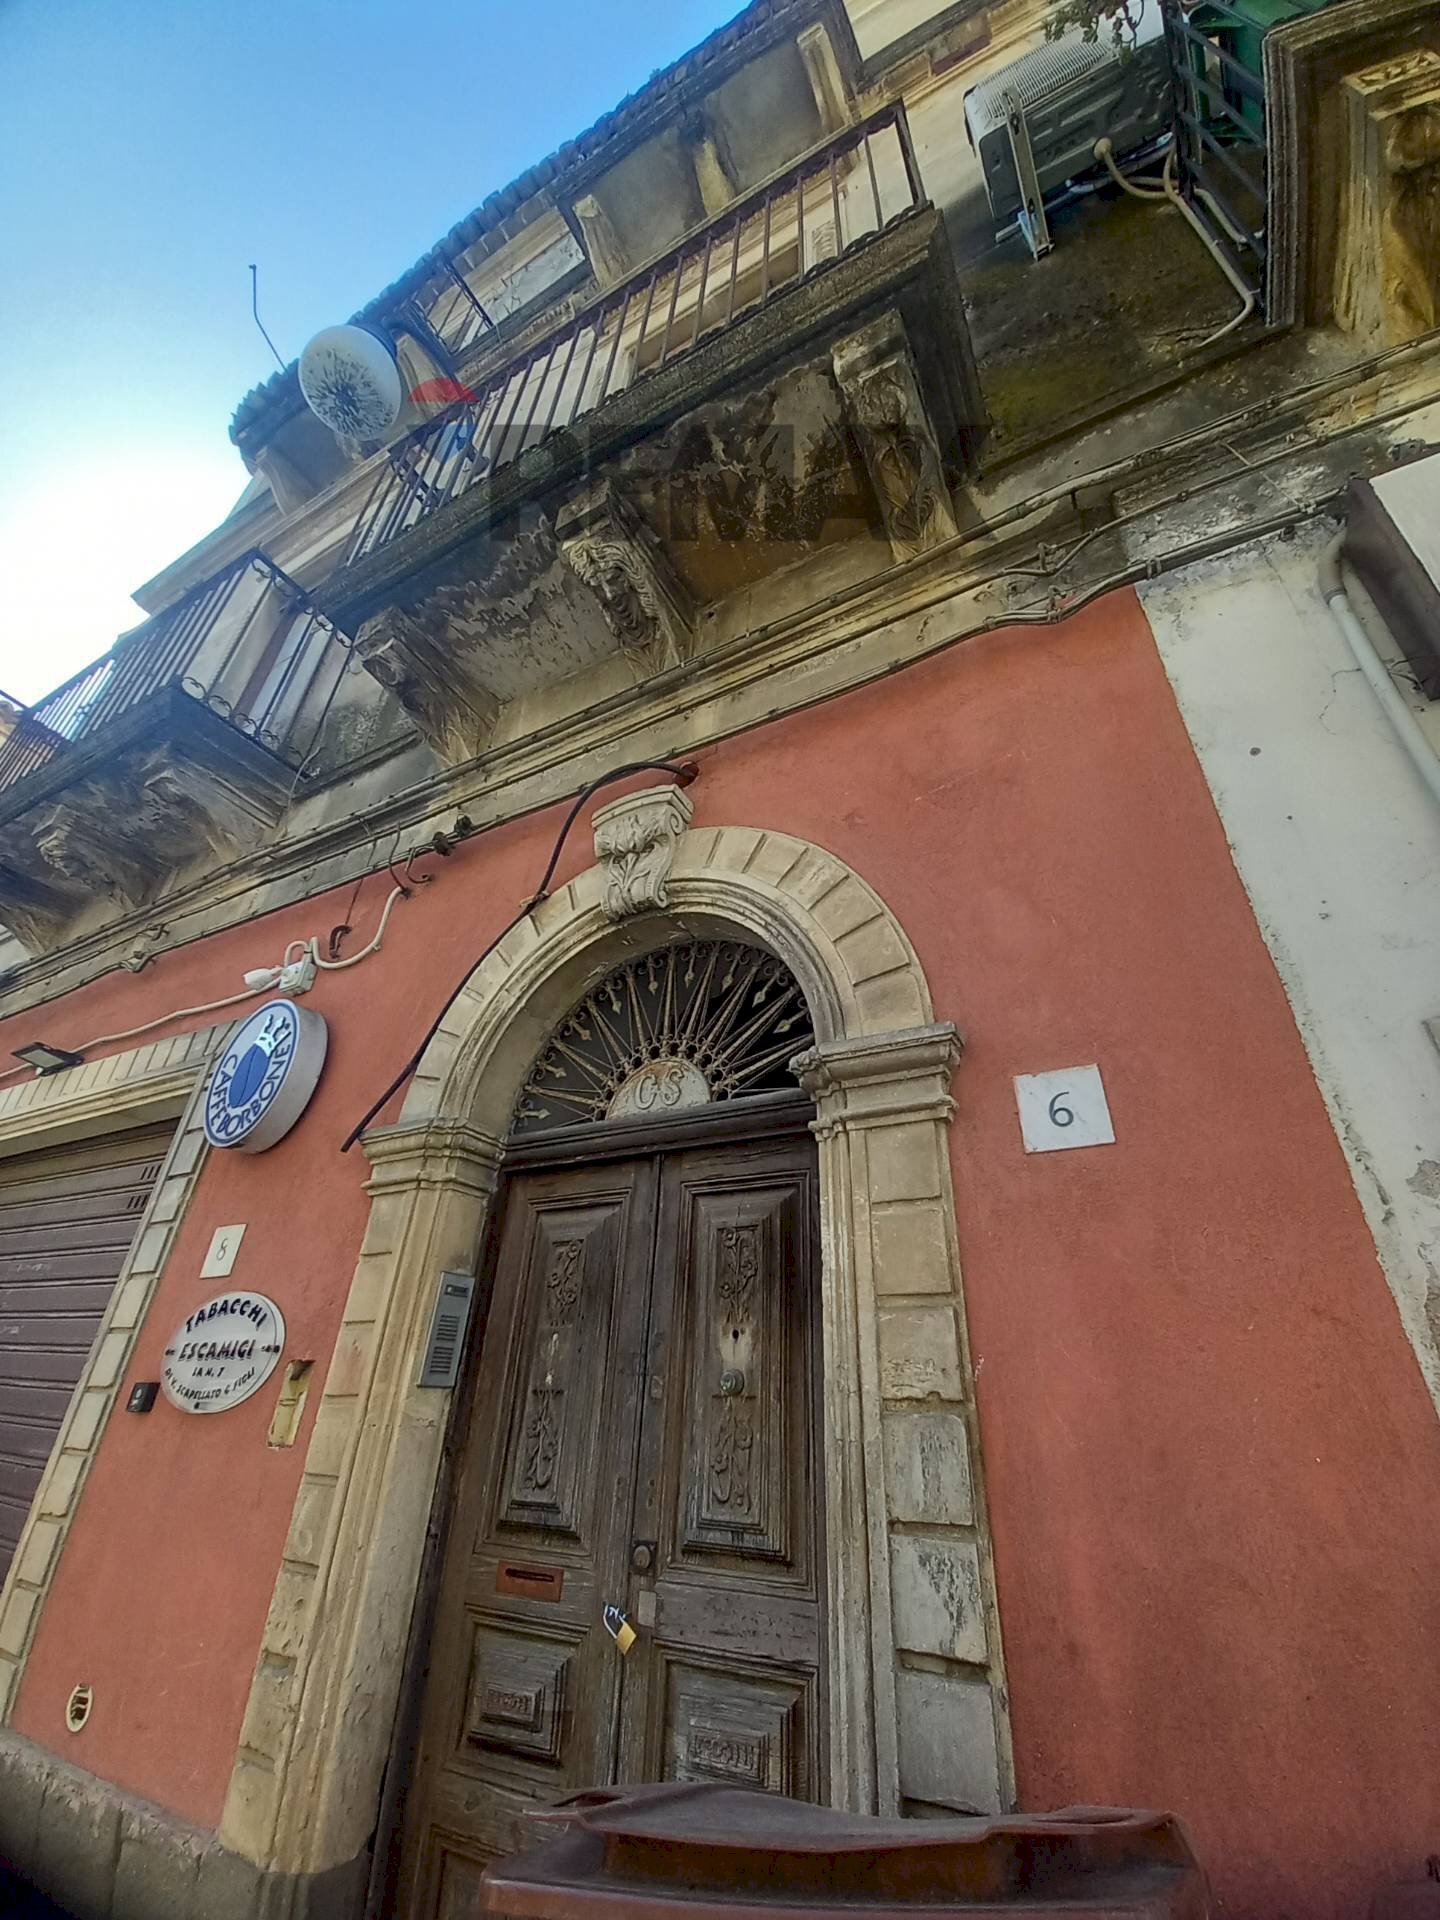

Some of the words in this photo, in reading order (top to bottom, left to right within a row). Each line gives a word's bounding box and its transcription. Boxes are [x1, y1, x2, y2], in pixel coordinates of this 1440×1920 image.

[216, 1044, 292, 1137] BORBONE
[1048, 1091, 1074, 1127] 6
[186, 1298, 267, 1333] TABACCHI
